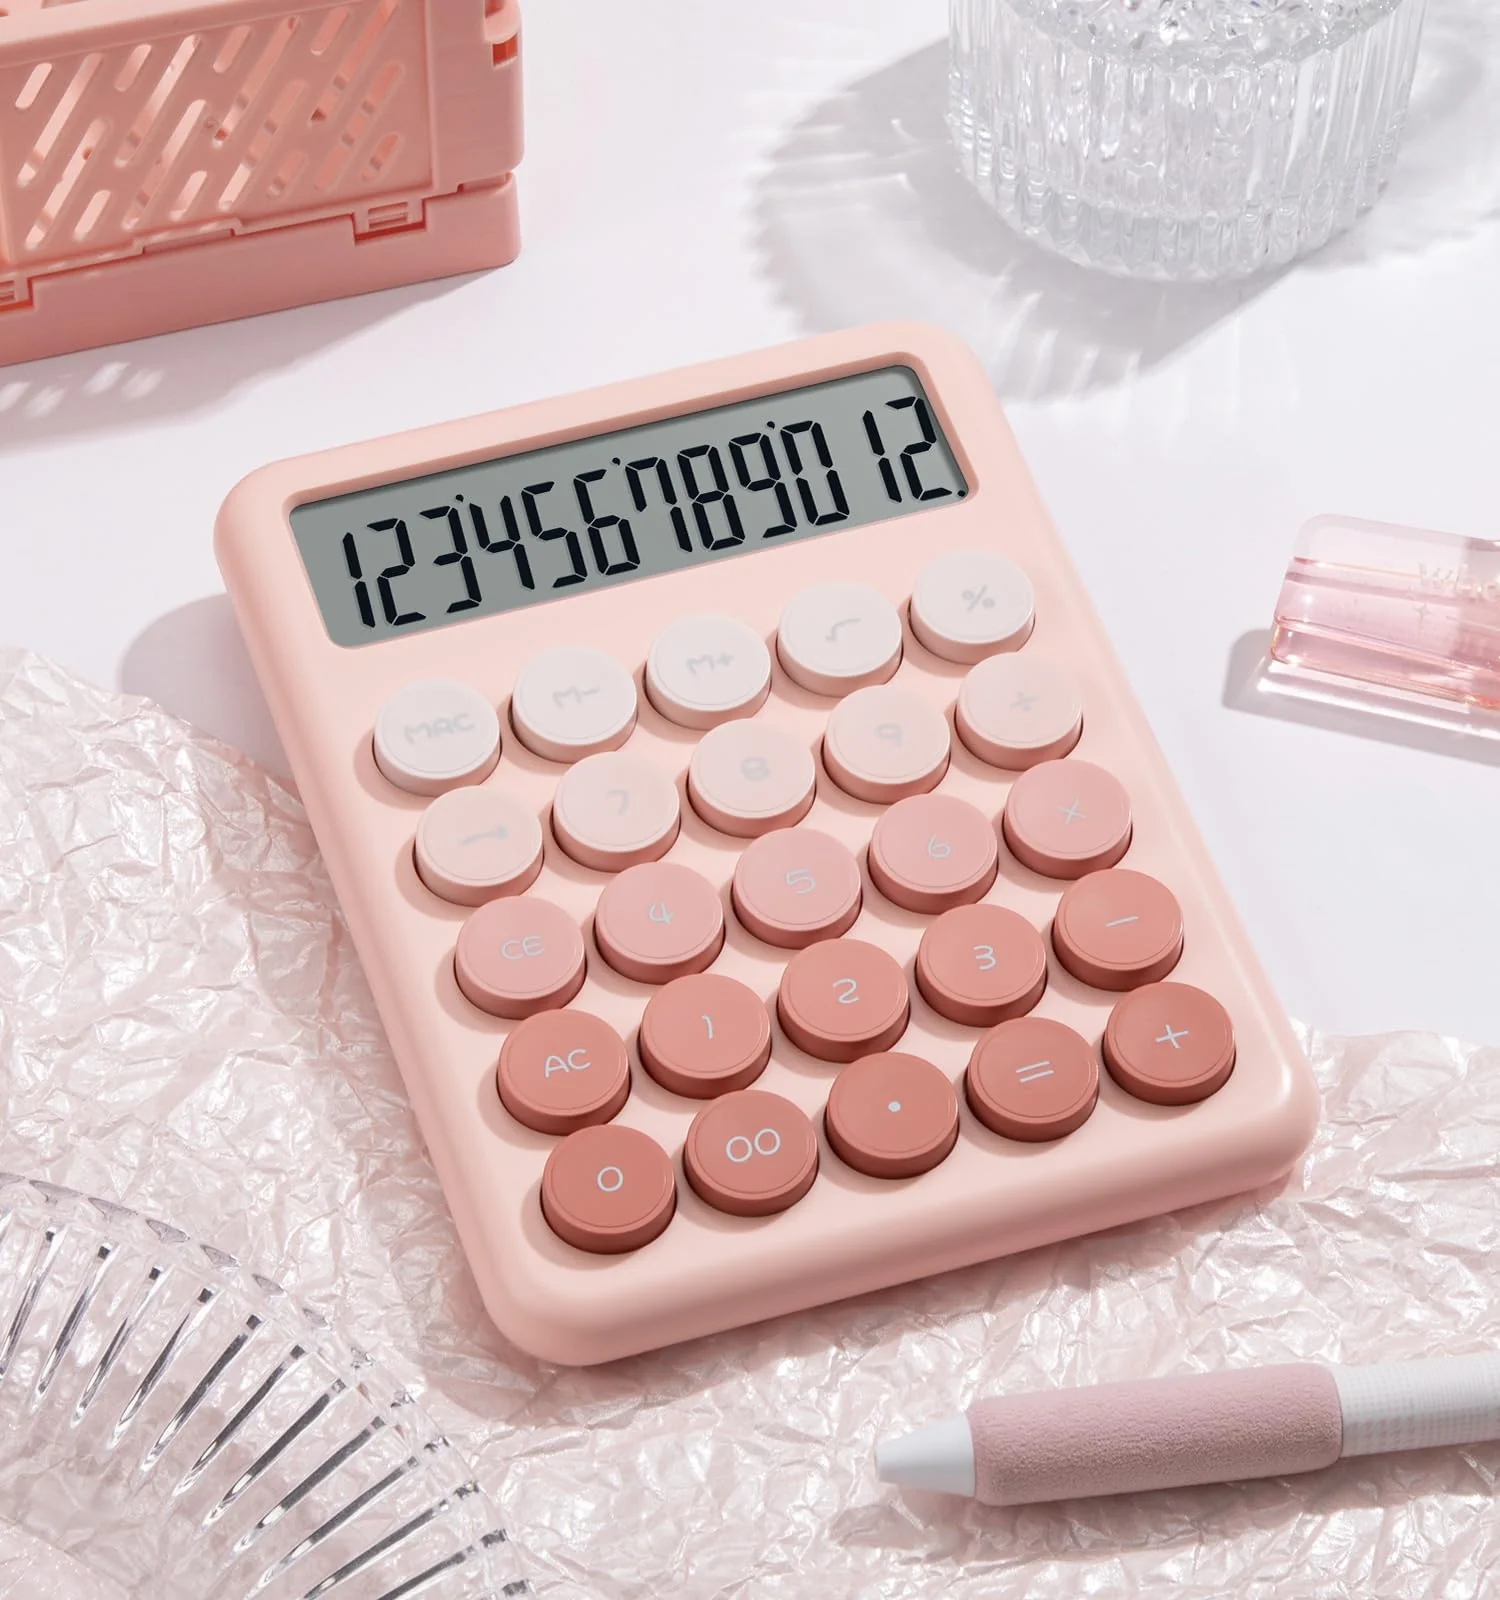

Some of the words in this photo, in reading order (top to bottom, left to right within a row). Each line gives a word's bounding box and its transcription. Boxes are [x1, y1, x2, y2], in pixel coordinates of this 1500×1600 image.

[875, 722, 904, 748] 9
[740, 756, 771, 783] 8
[927, 835, 953, 860] 6
[785, 868, 816, 896] 5
[648, 905, 674, 926] 4
[500, 934, 546, 961] CE
[973, 945, 998, 970] 3
[831, 978, 860, 1004] 2
[702, 1014, 715, 1040] 1
[543, 1049, 592, 1079] AC
[725, 1127, 782, 1163] 00
[596, 1165, 624, 1193] 0
